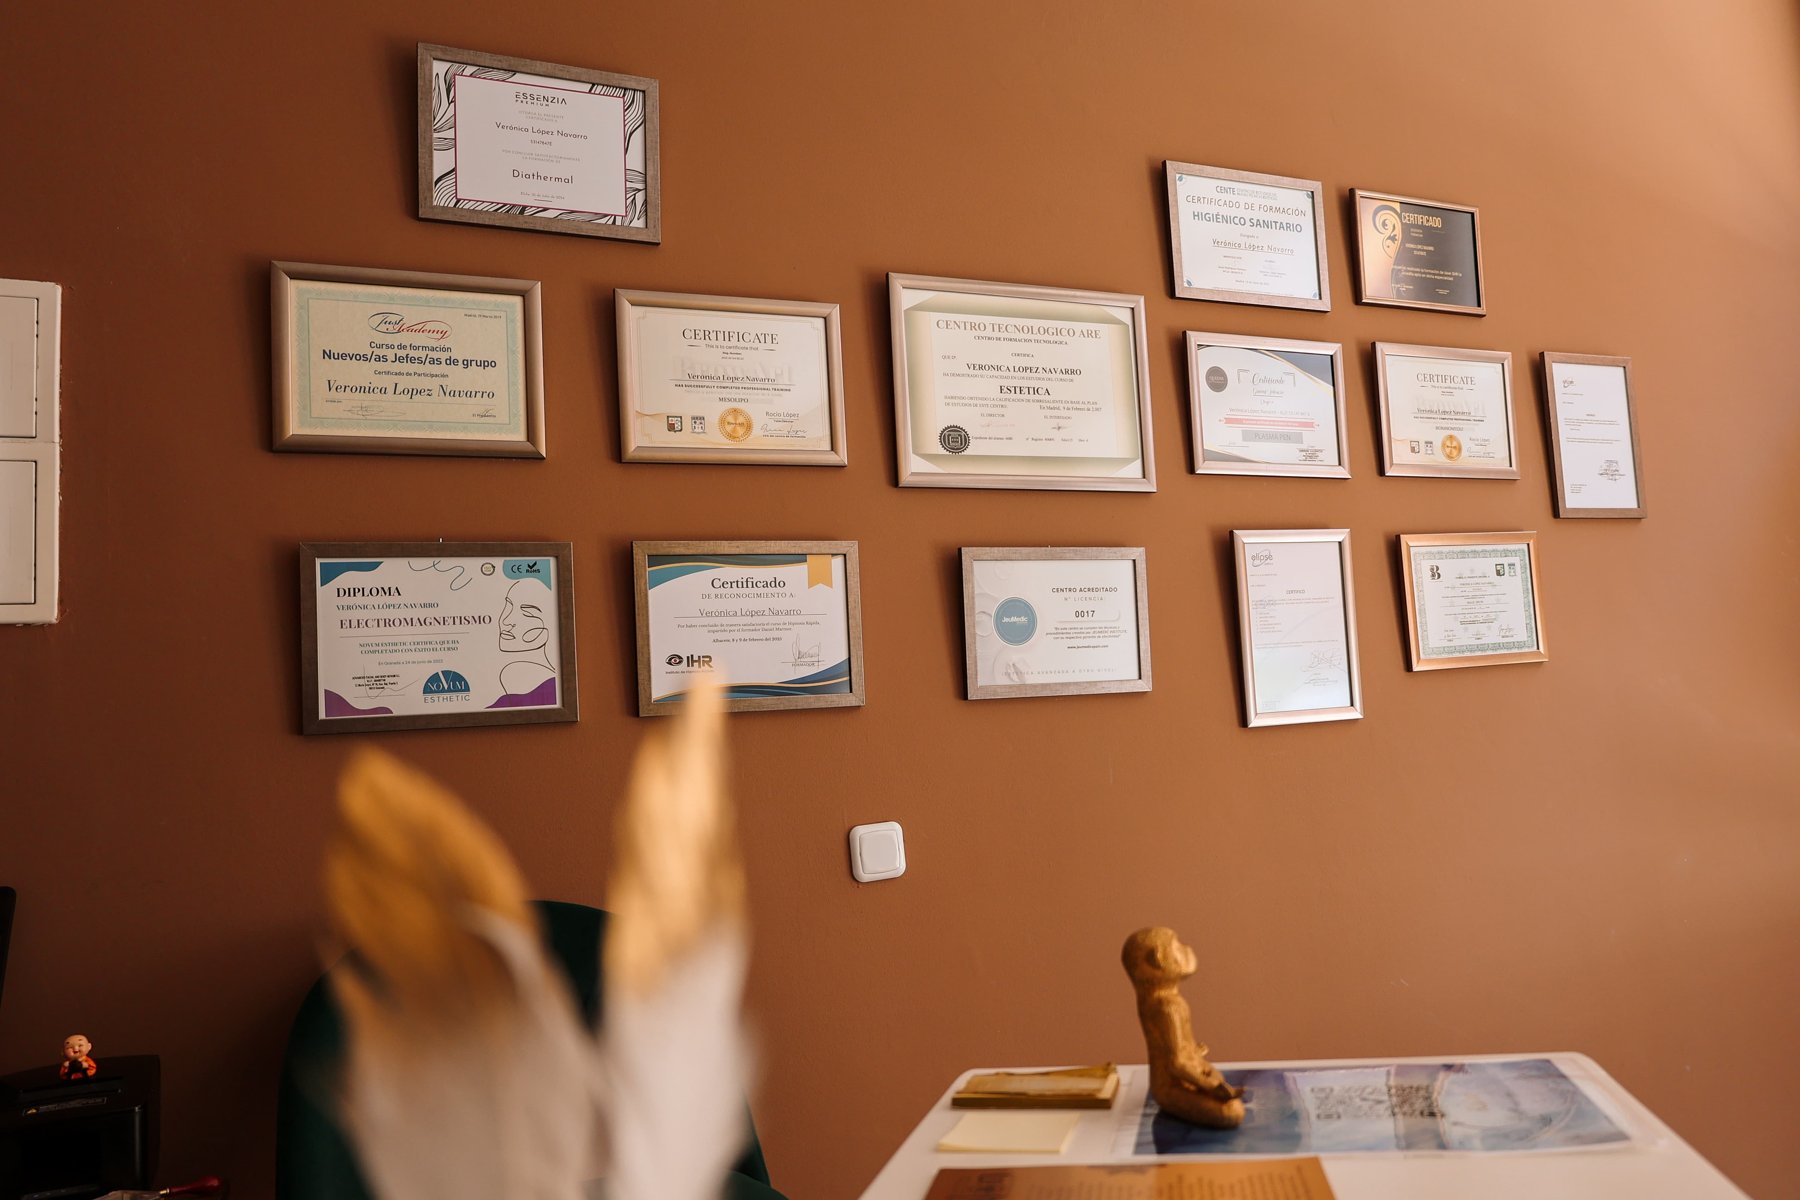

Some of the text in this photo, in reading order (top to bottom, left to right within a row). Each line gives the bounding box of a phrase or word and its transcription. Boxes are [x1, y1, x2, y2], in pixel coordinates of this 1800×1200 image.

[515, 91, 567, 105] ESSENZIA
[495, 122, 588, 140] Verónica López Navarro
[512, 169, 574, 184] Diathermal
[1215, 185, 1236, 195] CENTE
[1185, 194, 1241, 209] CERTIFICADO
[1244, 202, 1256, 211] DE
[1249, 217, 1303, 233] SANITARIO
[1401, 212, 1442, 228] CERTIFICADO
[1212, 238, 1295, 254] Verónica López Navarro
[386, 321, 449, 341] Academy
[682, 327, 779, 345] CERTIFICATE
[936, 319, 1102, 339] CENTRO TECNOLOGICO ARE
[369, 341, 452, 353] Curso de formación
[322, 349, 497, 370] Nuevos/as Jefes/as de grupo
[373, 369, 404, 377] Certificado
[413, 371, 449, 379] Participación
[966, 362, 1082, 376] VERONICA LOPEZ NAVARRO
[1416, 372, 1477, 386] CERTIFICATE
[326, 379, 496, 400] Veronica Lopez Navarro
[999, 385, 1051, 396] ESTETICA
[1279, 433, 1291, 441] PEN
[711, 576, 786, 589] Certificado
[336, 586, 402, 598] DIPLOMA
[336, 602, 376, 611] VERÓNICA
[377, 602, 402, 610] LÓPEZ
[698, 607, 802, 618] Verónica López Navarro
[1074, 610, 1096, 618] 0017
[339, 614, 492, 630] ELECTROMAGNETISMO
[686, 653, 713, 668] IHR
[428, 674, 465, 691] NOVUM
[423, 694, 471, 704] ESTHETIC
